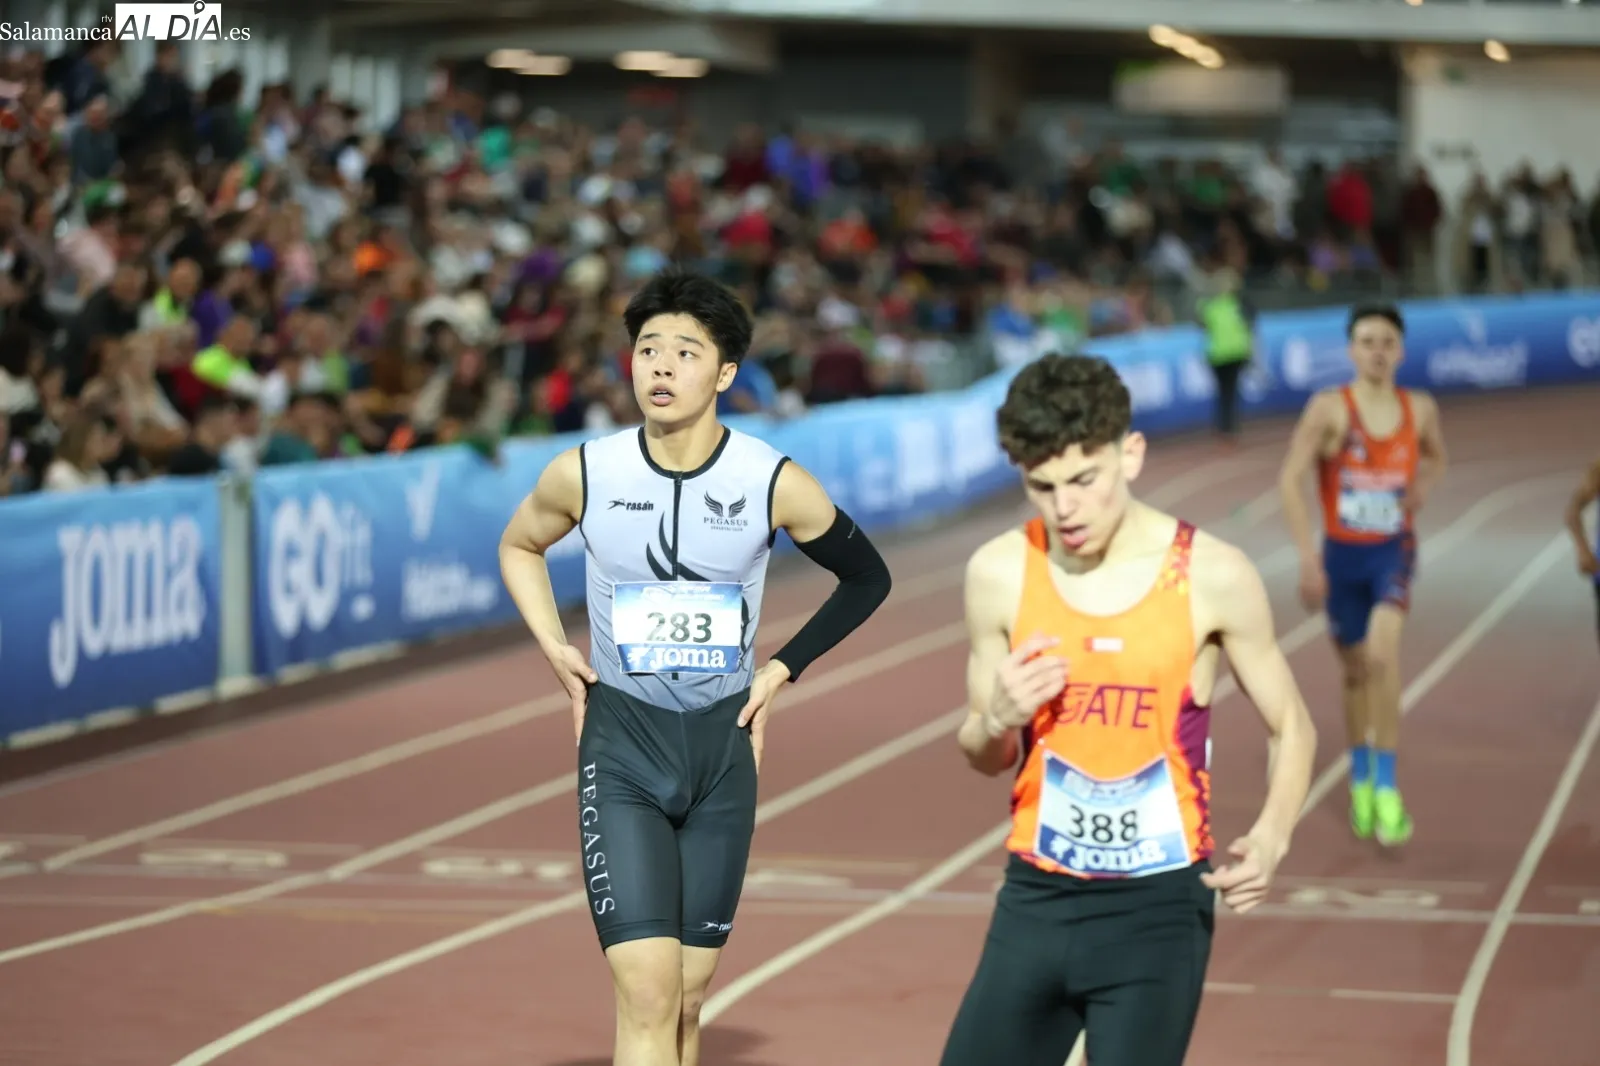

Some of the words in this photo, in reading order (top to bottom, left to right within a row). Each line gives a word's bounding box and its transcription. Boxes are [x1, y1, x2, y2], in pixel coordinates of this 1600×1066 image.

[703, 516, 749, 527] PEGASUS
[645, 612, 712, 643] 283
[582, 761, 616, 916] PEGASUS
[1068, 804, 1138, 844] 388
